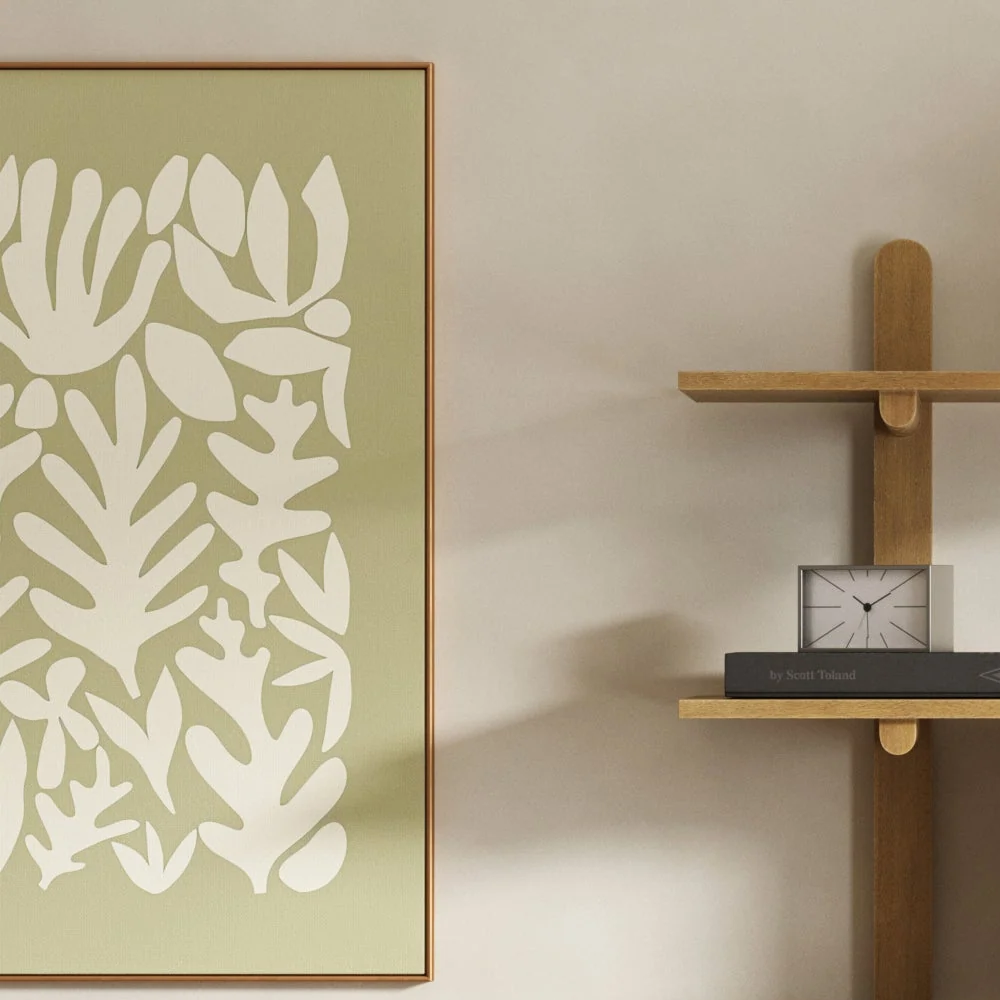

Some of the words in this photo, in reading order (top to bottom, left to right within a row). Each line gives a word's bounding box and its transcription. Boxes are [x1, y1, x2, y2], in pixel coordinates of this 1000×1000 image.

[769, 669, 784, 684] by
[786, 669, 815, 681] Scott
[816, 669, 857, 681] Toland
